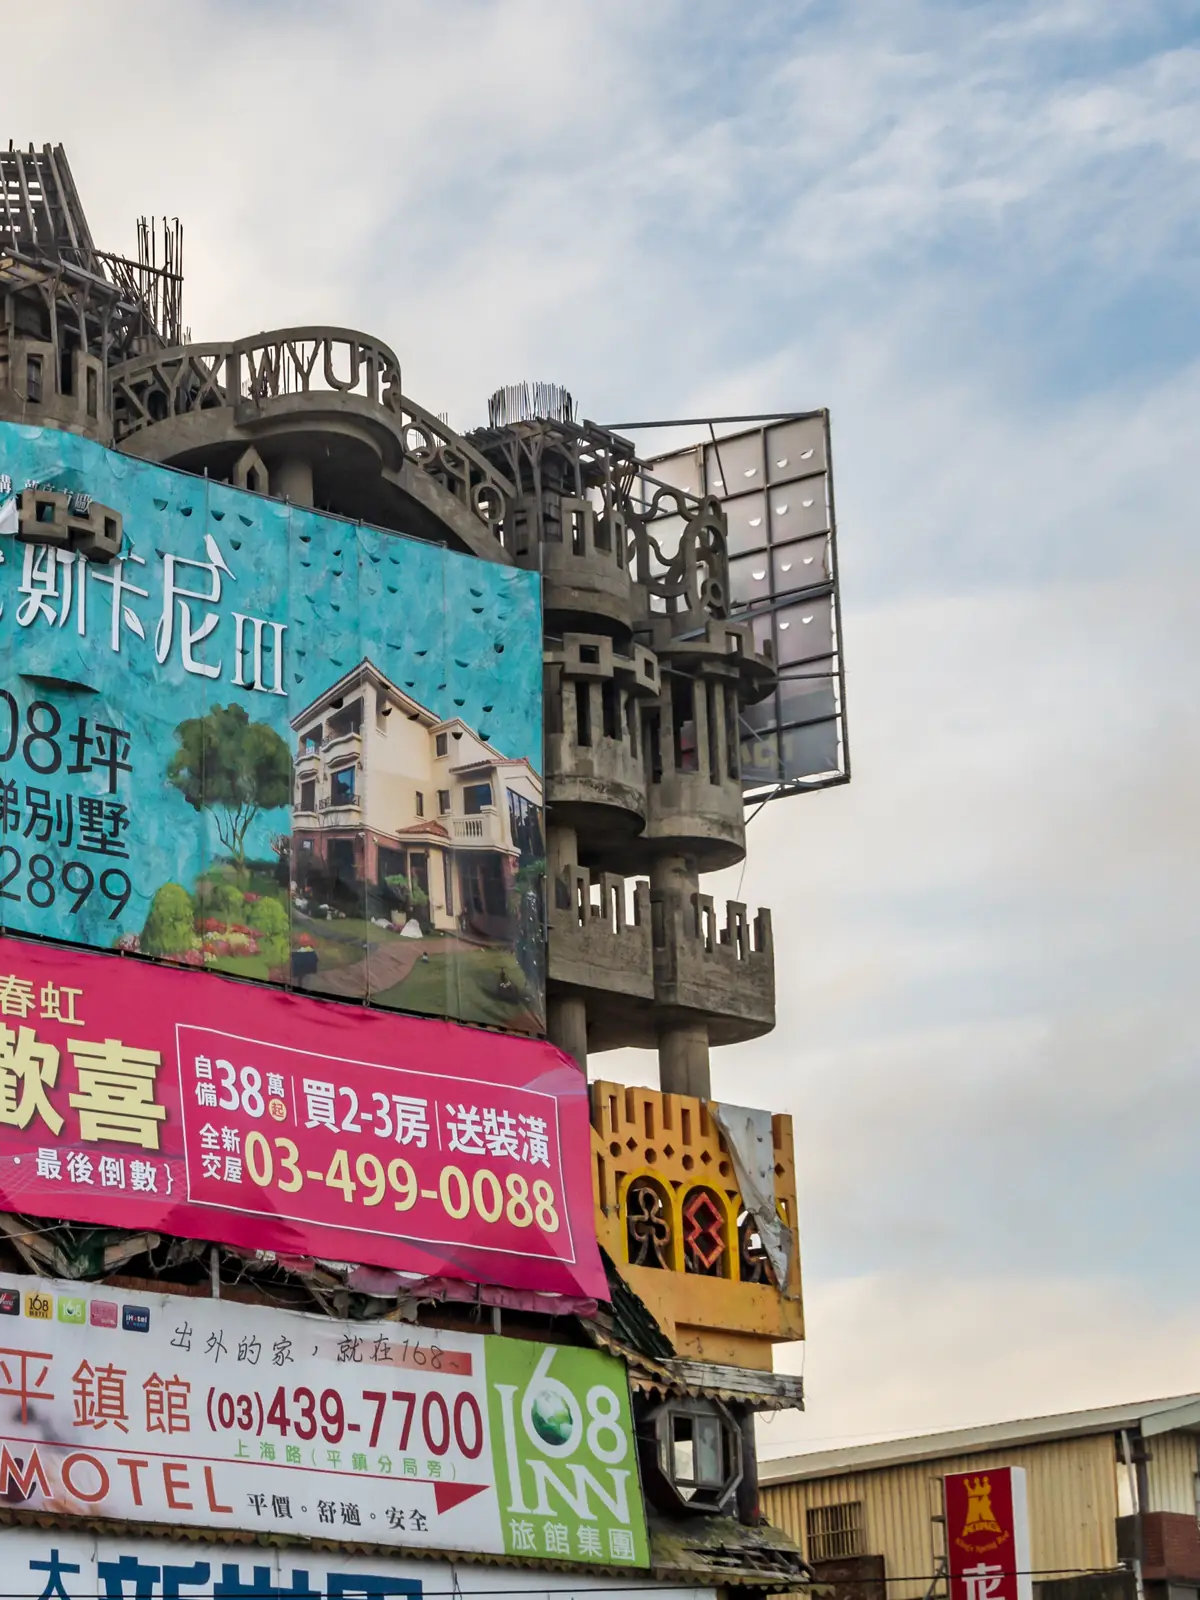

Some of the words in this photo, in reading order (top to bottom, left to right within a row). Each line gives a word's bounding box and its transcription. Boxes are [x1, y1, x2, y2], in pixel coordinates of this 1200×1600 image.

[199, 1123, 240, 1154] 全新
[303, 1078, 430, 1149] 買2-3房
[445, 1102, 551, 1169] 送裝潢
[201, 1152, 243, 1184] 交屋
[244, 1130, 559, 1233] 03-499-0088
[206, 1385, 484, 1460] (03)439-7700
[508, 1518, 635, 1561] 旅館集團
